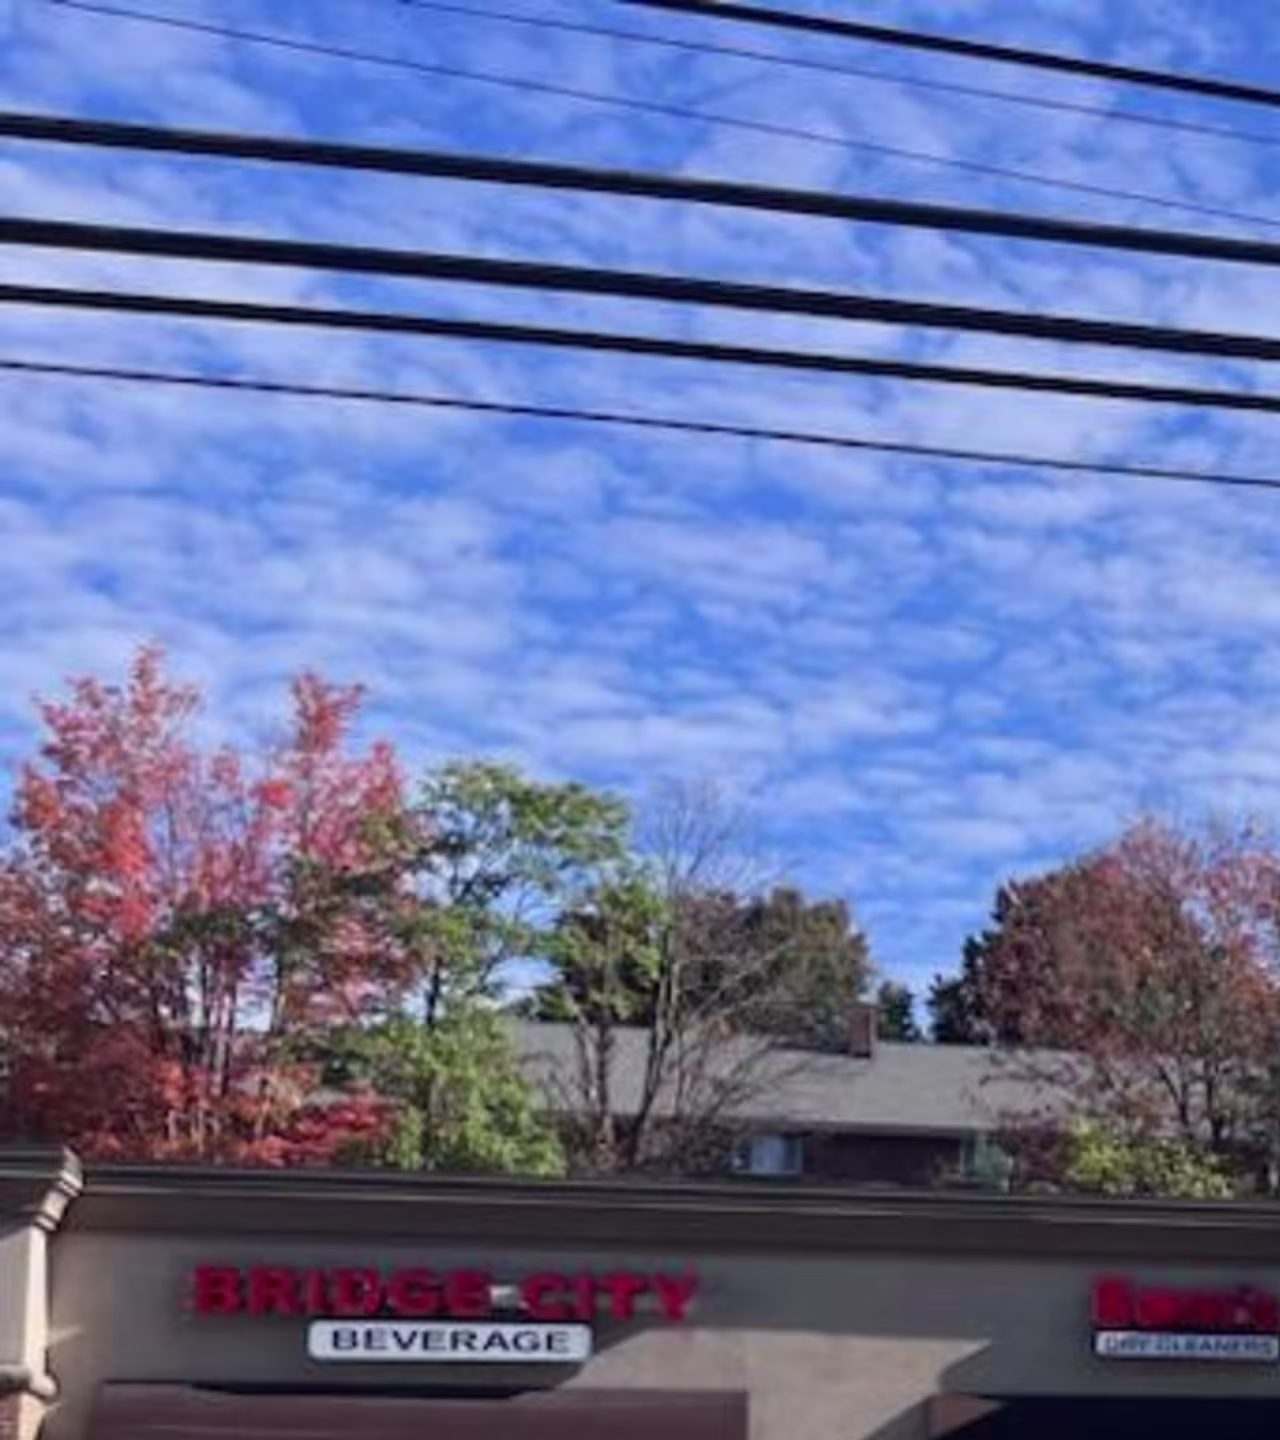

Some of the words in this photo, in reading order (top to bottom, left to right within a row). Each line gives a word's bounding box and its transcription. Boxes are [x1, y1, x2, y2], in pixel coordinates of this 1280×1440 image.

[193, 1265, 491, 1317] BRIDGE
[521, 1270, 699, 1322] CITY
[330, 1328, 571, 1354] BEVERAGE
[1156, 1335, 1272, 1354] CLEANERS
